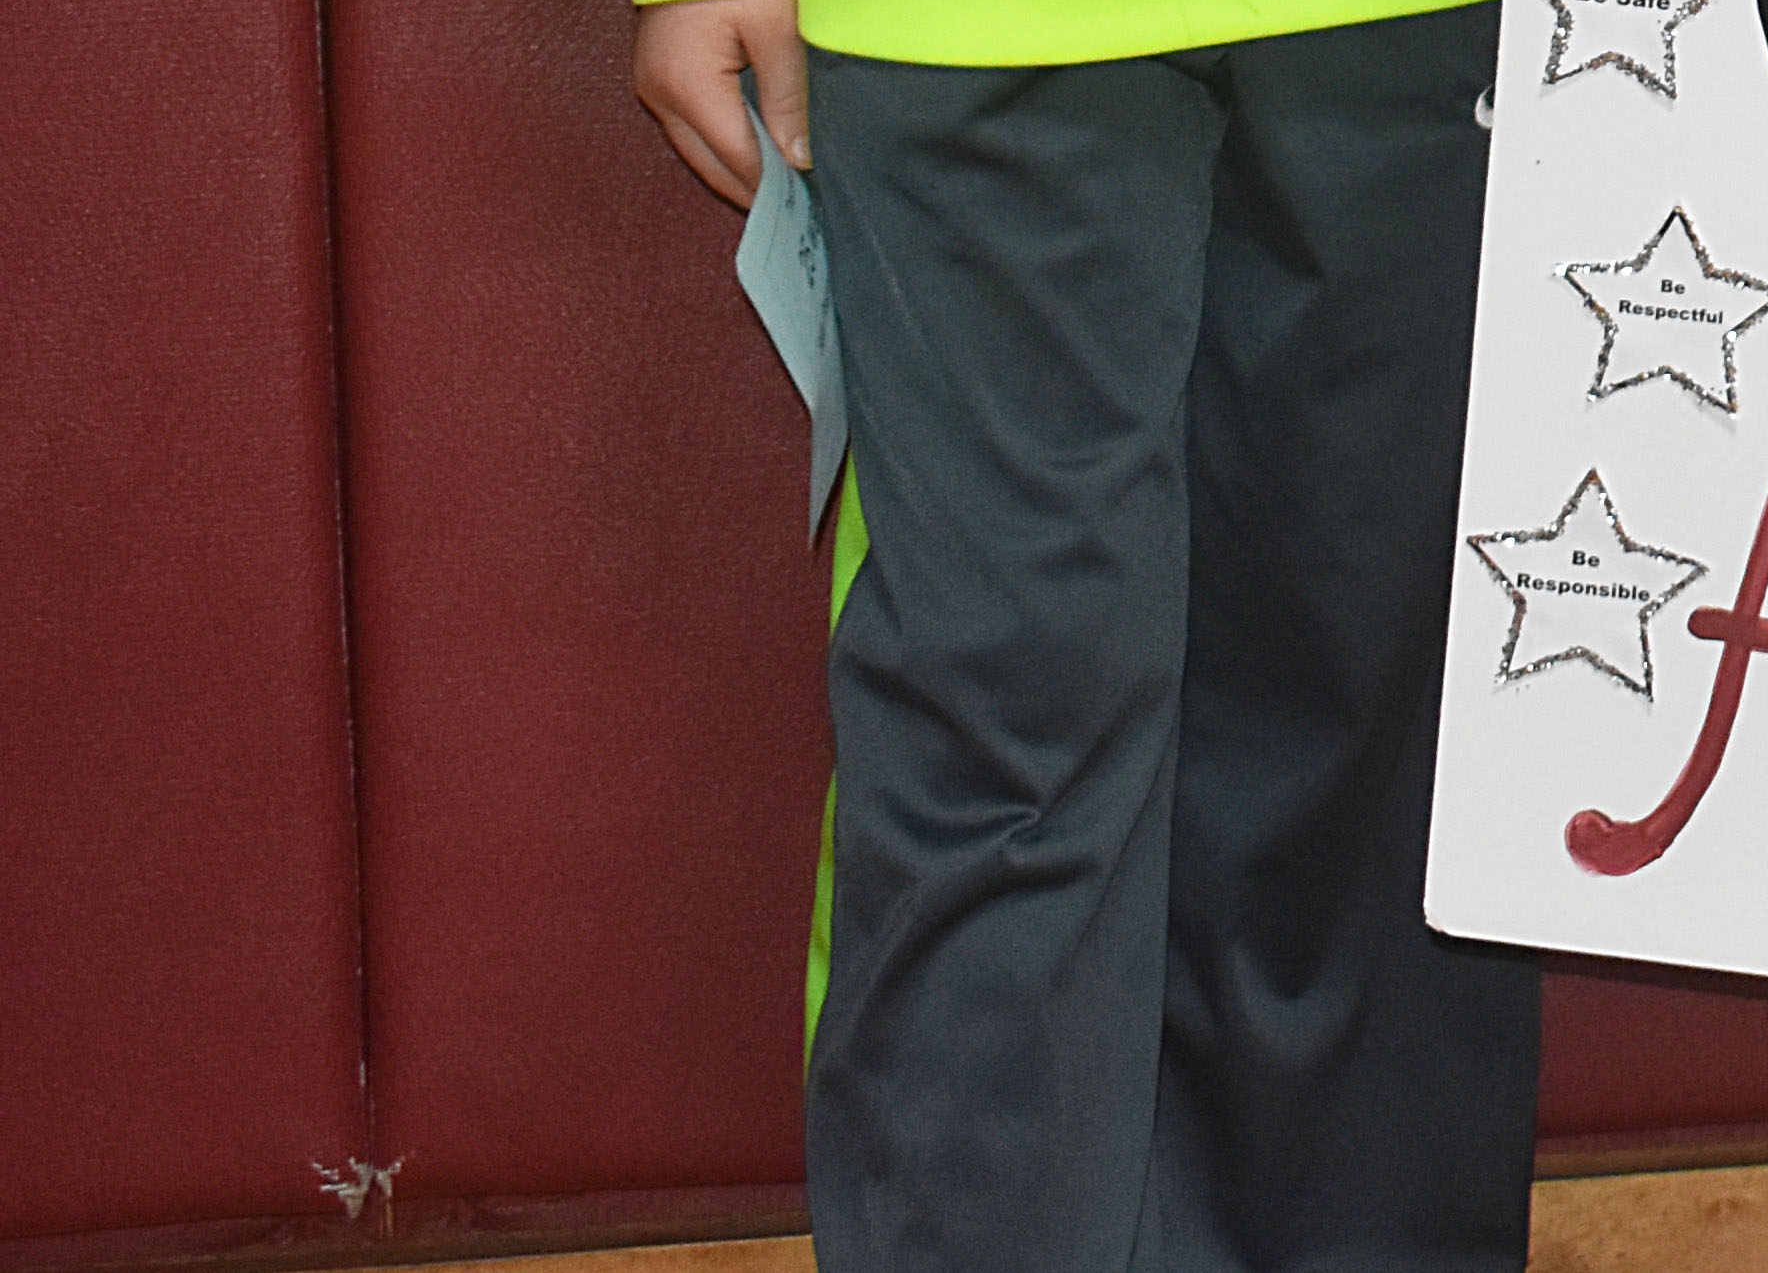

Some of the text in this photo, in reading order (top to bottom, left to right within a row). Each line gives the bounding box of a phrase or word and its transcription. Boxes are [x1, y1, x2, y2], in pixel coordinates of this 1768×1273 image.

[1660, 279, 1686, 295] Be
[1618, 299, 1724, 324] Respectful
[1571, 549, 1601, 567] Be
[1516, 573, 1651, 602] Responsible
